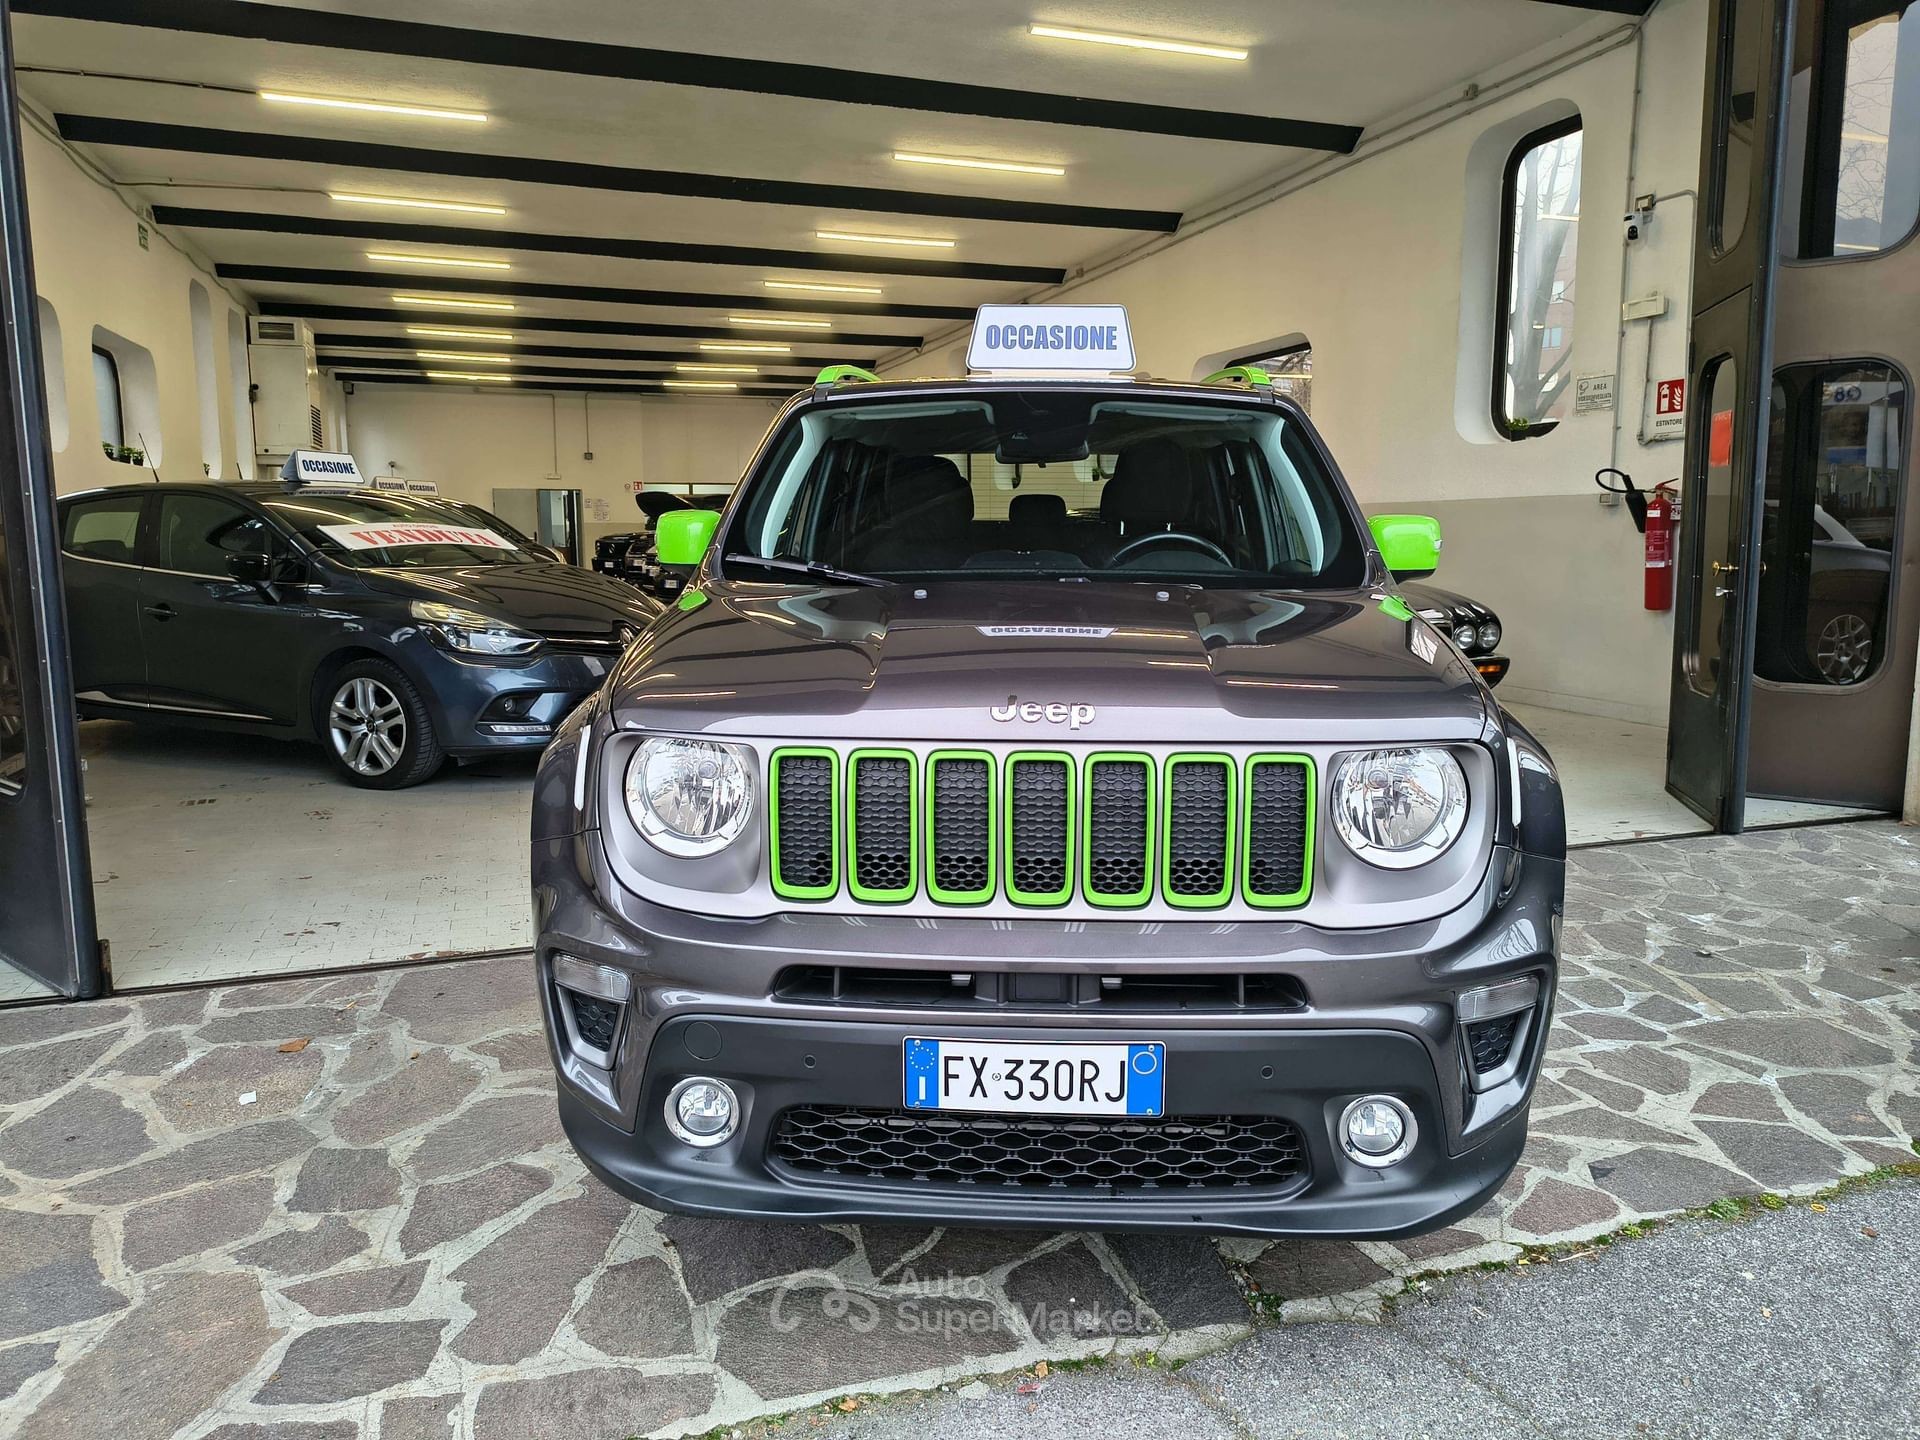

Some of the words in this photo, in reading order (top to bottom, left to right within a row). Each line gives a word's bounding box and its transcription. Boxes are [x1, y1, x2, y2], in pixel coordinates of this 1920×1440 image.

[985, 324, 1118, 351] OCCASIONE
[1593, 383, 1608, 391] AREA
[1655, 418, 1683, 427] ESTINTORE
[301, 459, 356, 475] OCCASIONE
[378, 481, 406, 491] OCCASIONE
[408, 484, 436, 492] OCCASIONE
[350, 529, 502, 547] VENDUTA
[989, 694, 1097, 731] Jeep
[918, 1075, 927, 1101] I
